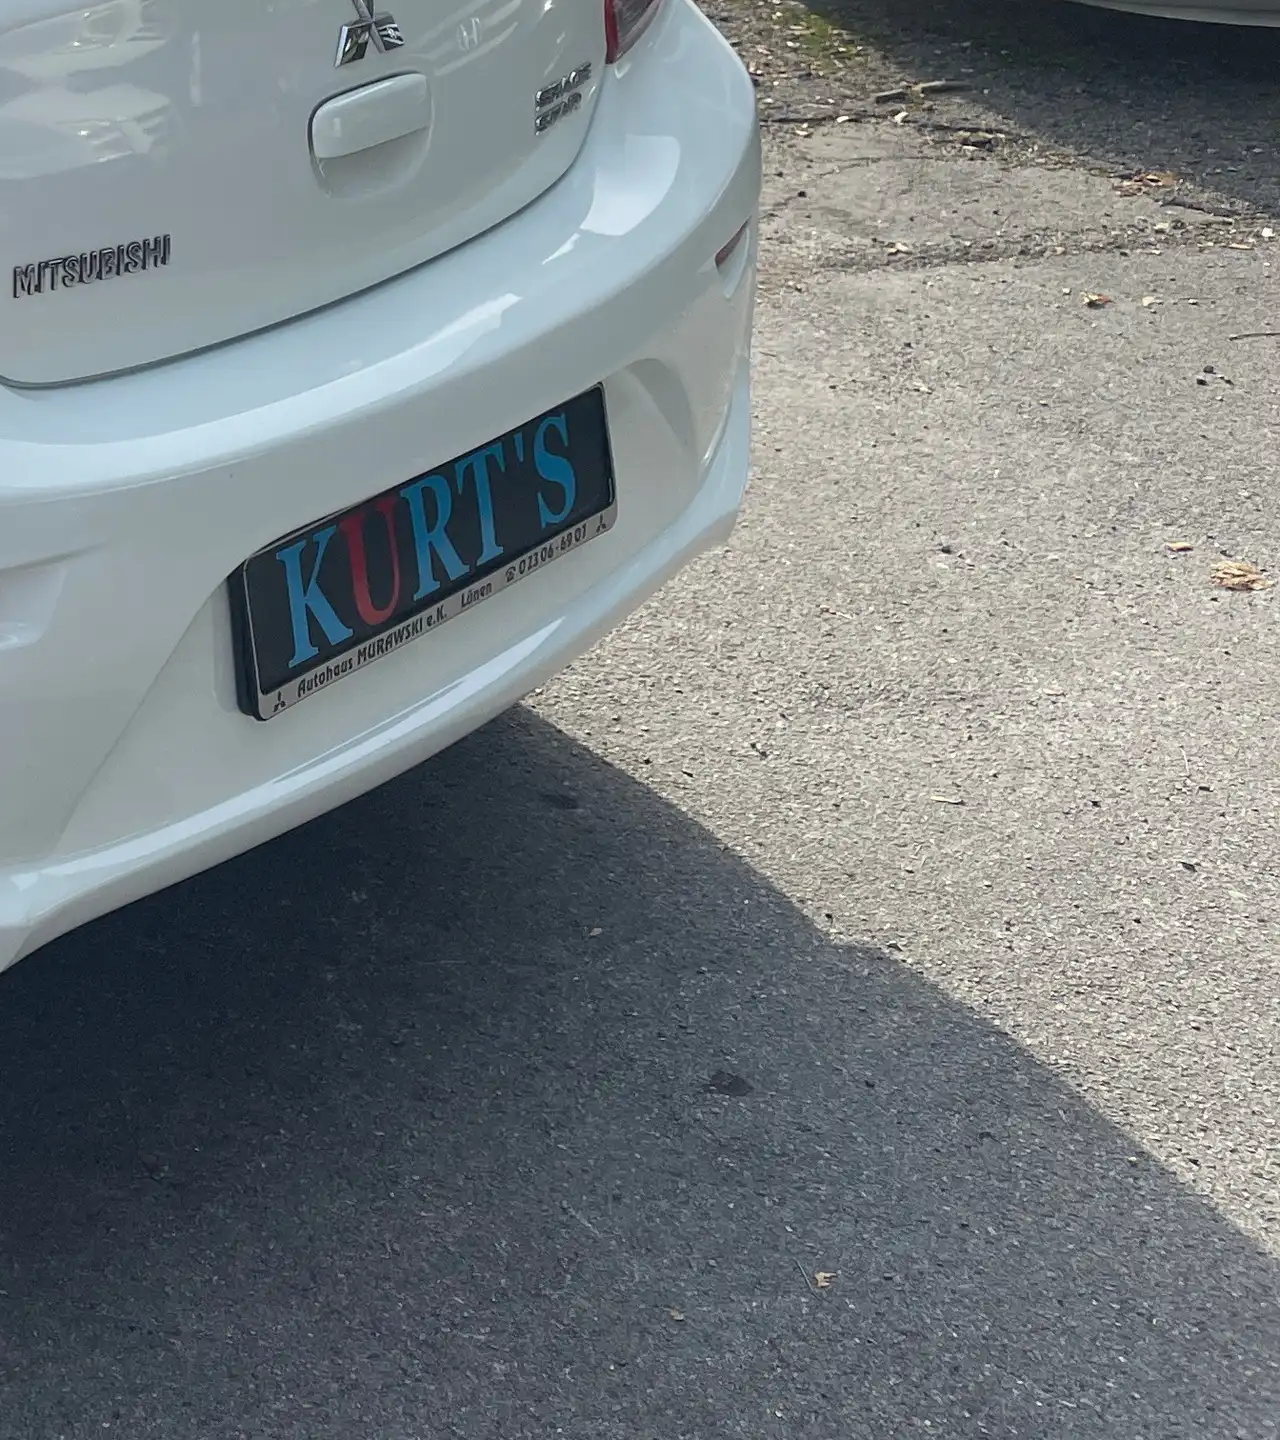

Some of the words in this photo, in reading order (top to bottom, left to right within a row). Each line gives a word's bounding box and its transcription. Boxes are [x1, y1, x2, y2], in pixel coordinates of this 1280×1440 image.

[13, 234, 172, 298] MITSUBISHI
[276, 413, 577, 668] KURT'S
[297, 657, 354, 698] Autohaus
[357, 617, 423, 666] MURAWSKI
[461, 582, 493, 608] Lünen
